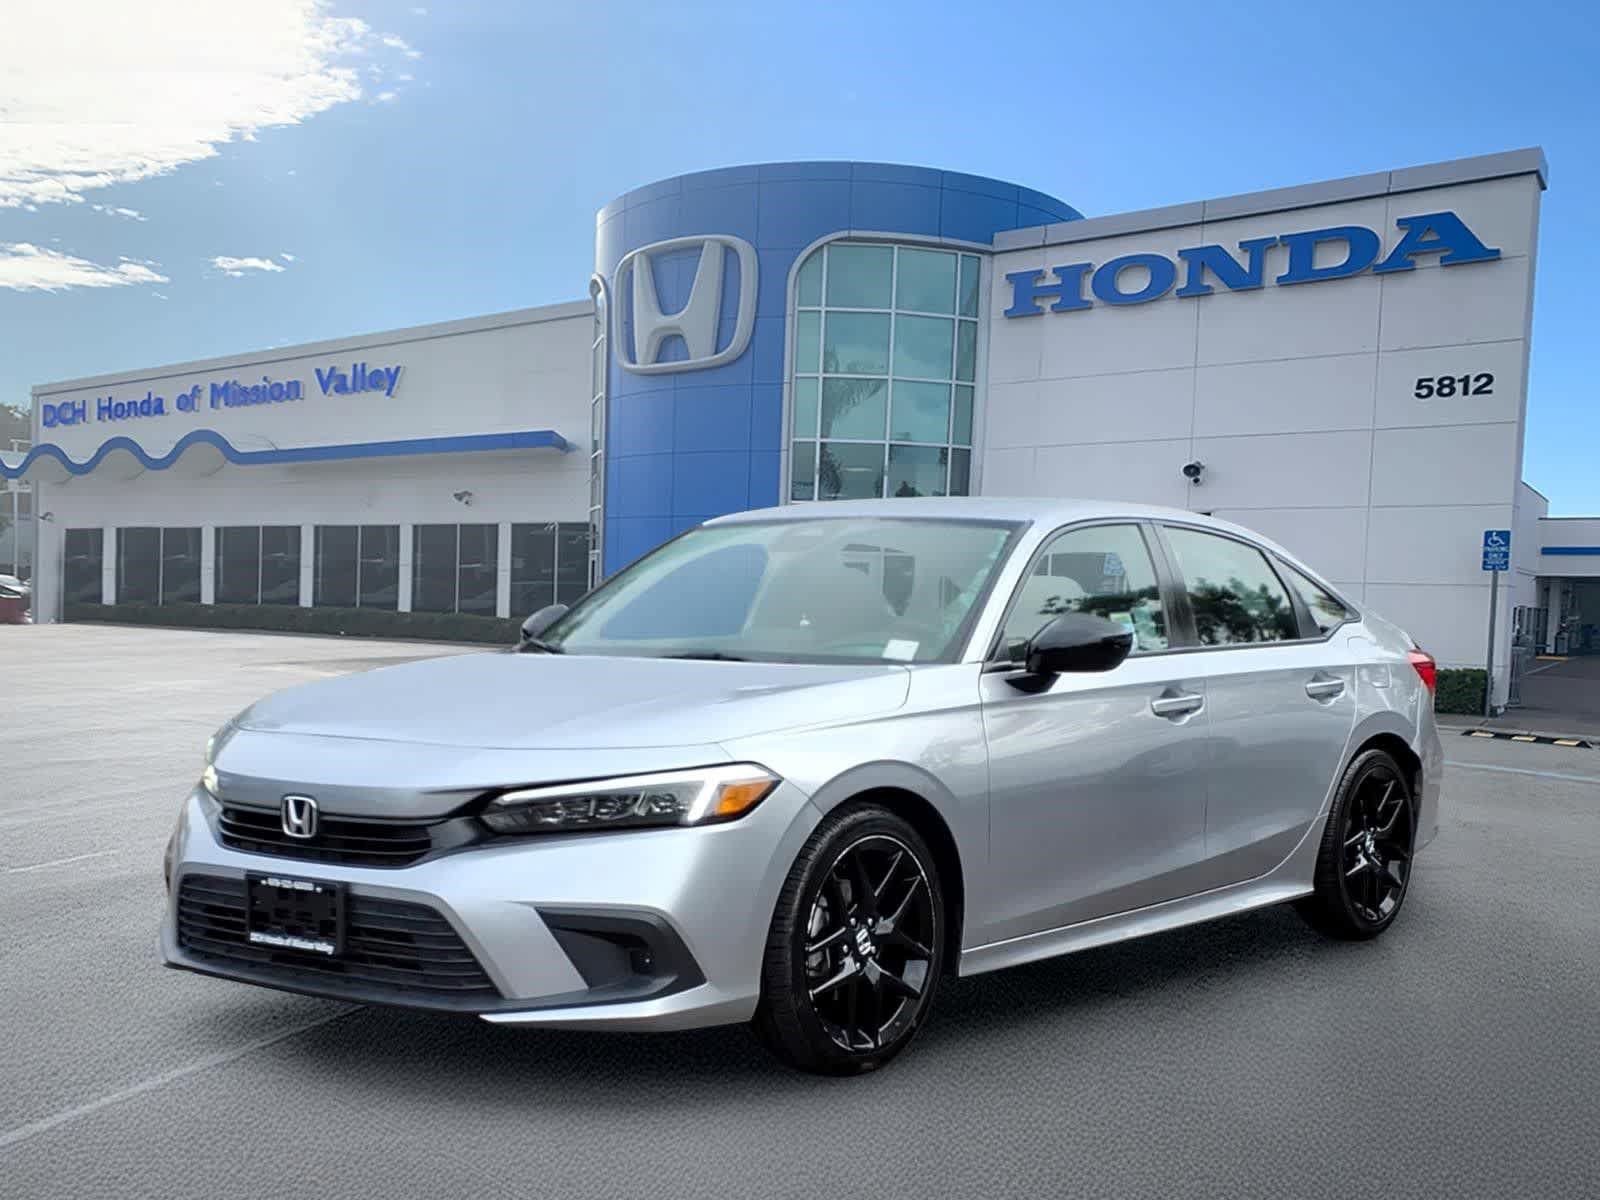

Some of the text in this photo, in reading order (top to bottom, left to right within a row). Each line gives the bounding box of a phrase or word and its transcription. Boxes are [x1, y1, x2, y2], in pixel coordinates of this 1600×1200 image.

[1003, 210, 1503, 318] HONDA
[42, 363, 403, 428] DCH Honda of Mission Valley
[1413, 373, 1494, 400] 5812
